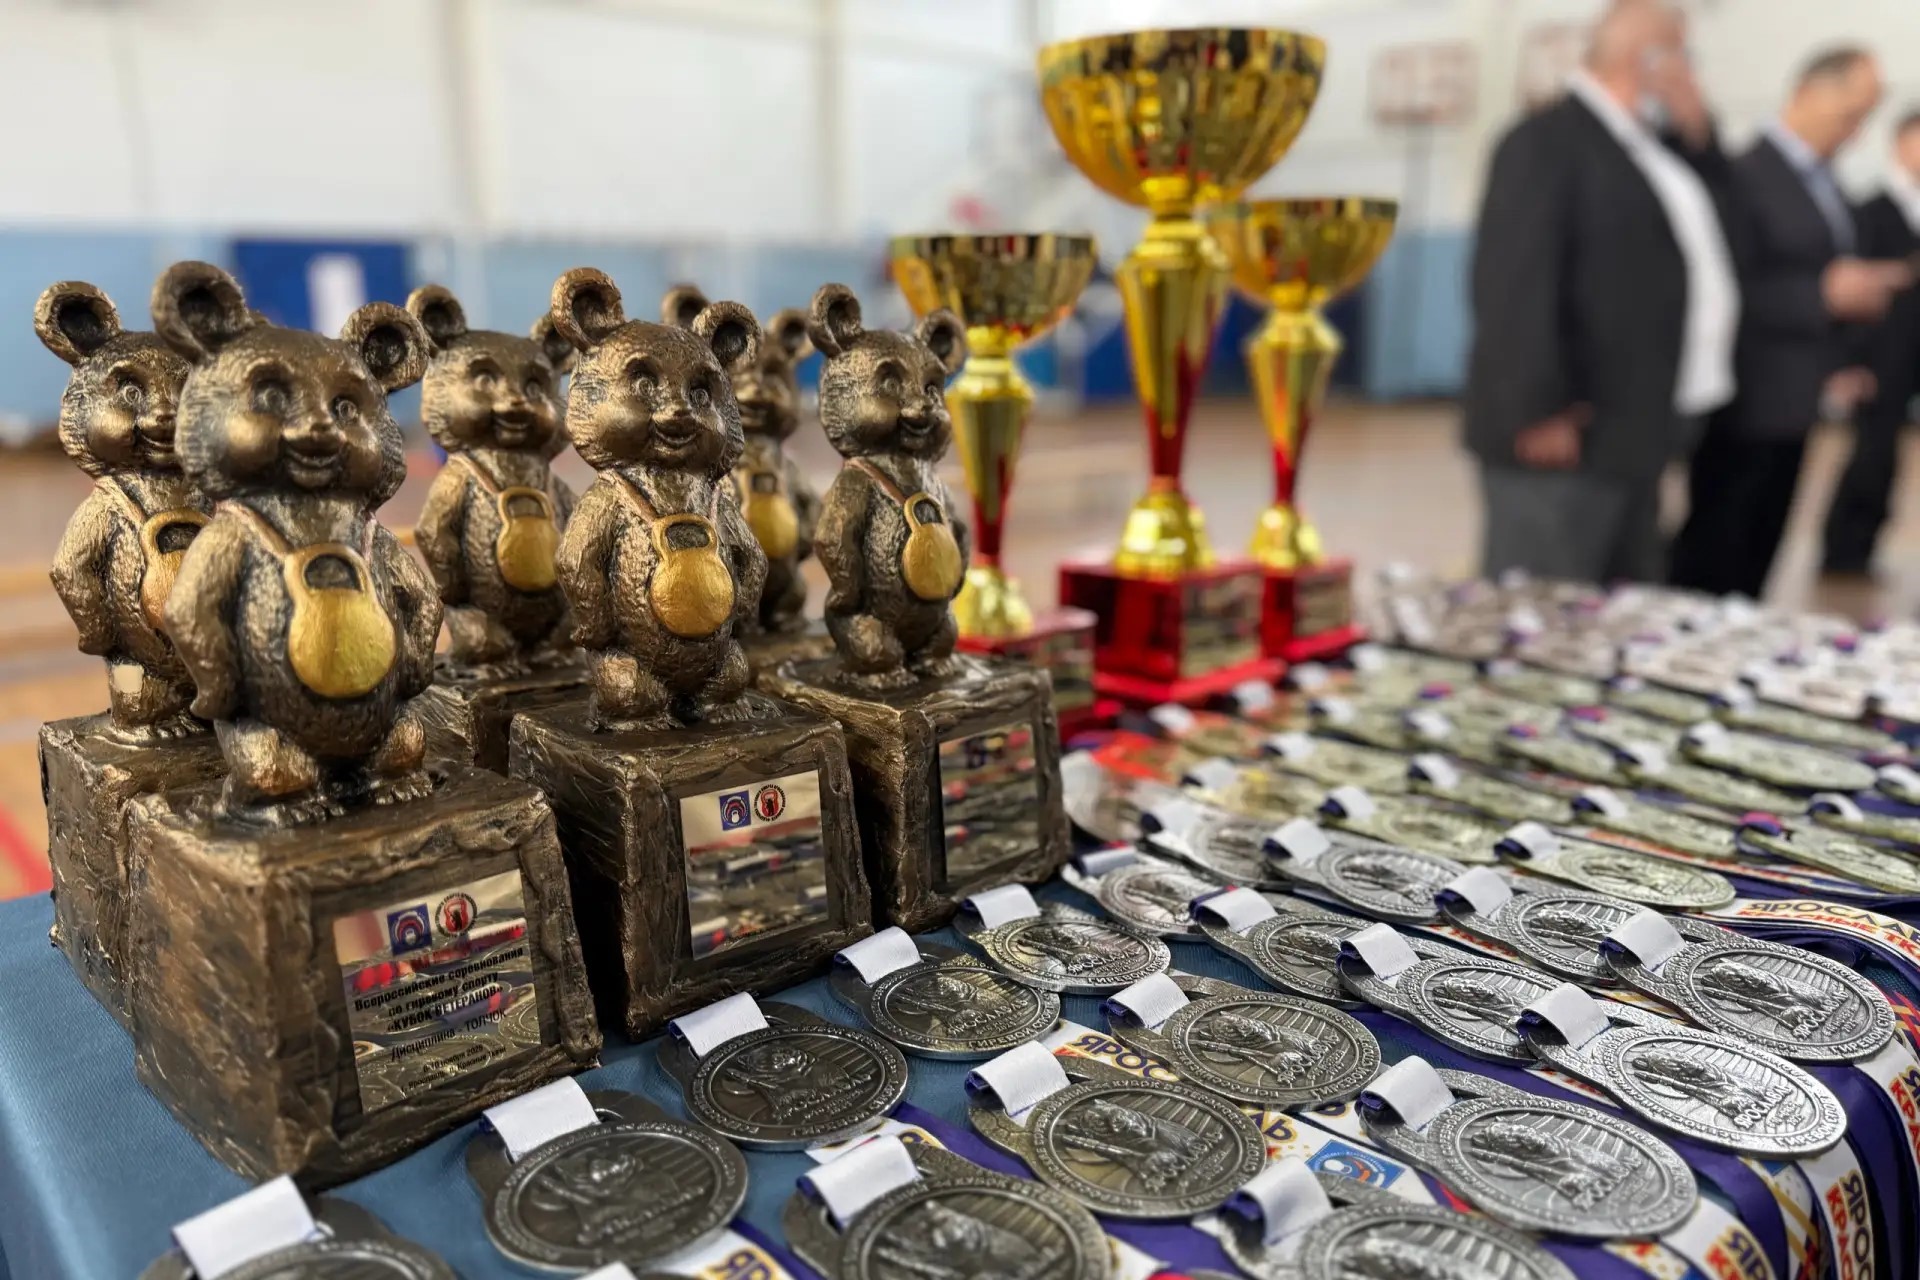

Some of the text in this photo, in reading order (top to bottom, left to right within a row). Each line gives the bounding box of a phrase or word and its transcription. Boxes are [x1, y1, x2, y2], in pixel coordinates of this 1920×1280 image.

[355, 948, 523, 1011] Всероссийские соревнования
[388, 1004, 403, 1017] по
[462, 973, 498, 993] спорту
[391, 1028, 456, 1060] Дисциплина
[465, 1008, 506, 1032] ТОЛЧОК
[968, 1027, 1038, 1048] ГИРЕВОЙ
[1824, 1026, 1886, 1052] ГИРЕВОЙ
[1768, 1121, 1839, 1146] ГИРЕВОЙ
